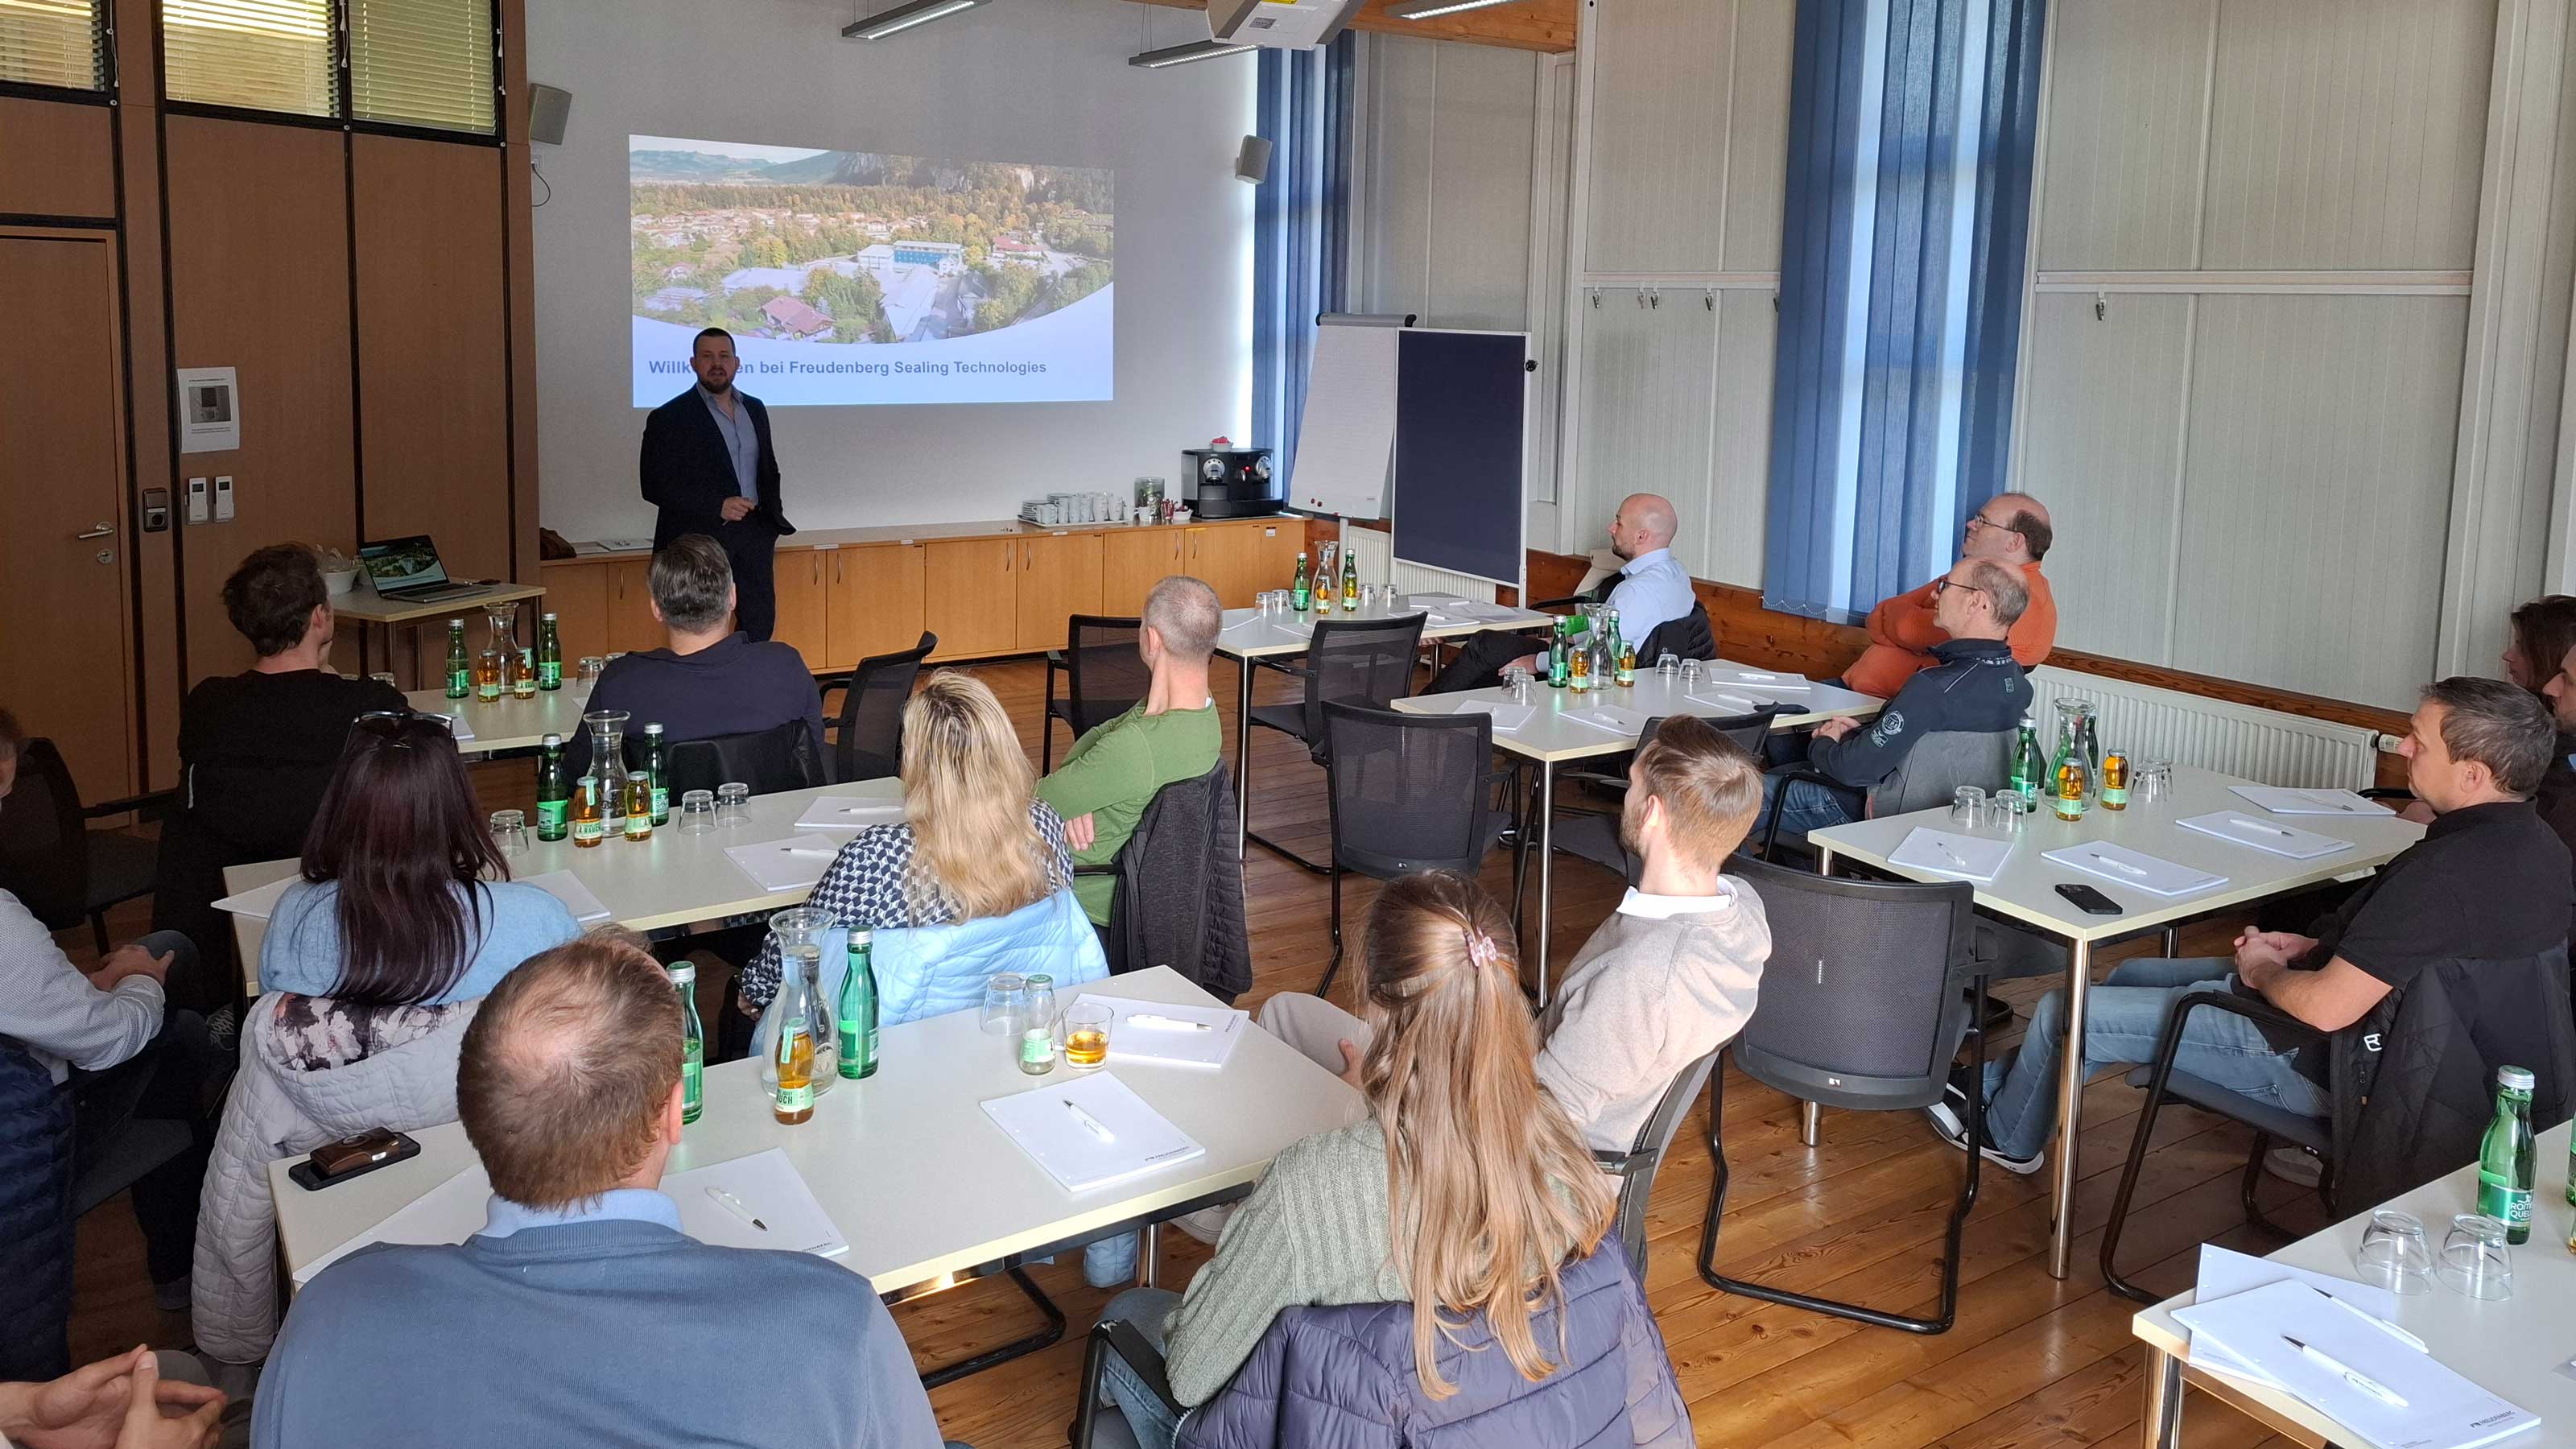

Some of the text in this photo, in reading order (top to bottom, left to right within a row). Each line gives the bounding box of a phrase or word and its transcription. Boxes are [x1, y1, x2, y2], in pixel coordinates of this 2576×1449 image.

[649, 361, 1047, 377] Willken bei Freudenberg Sealing Technologies
